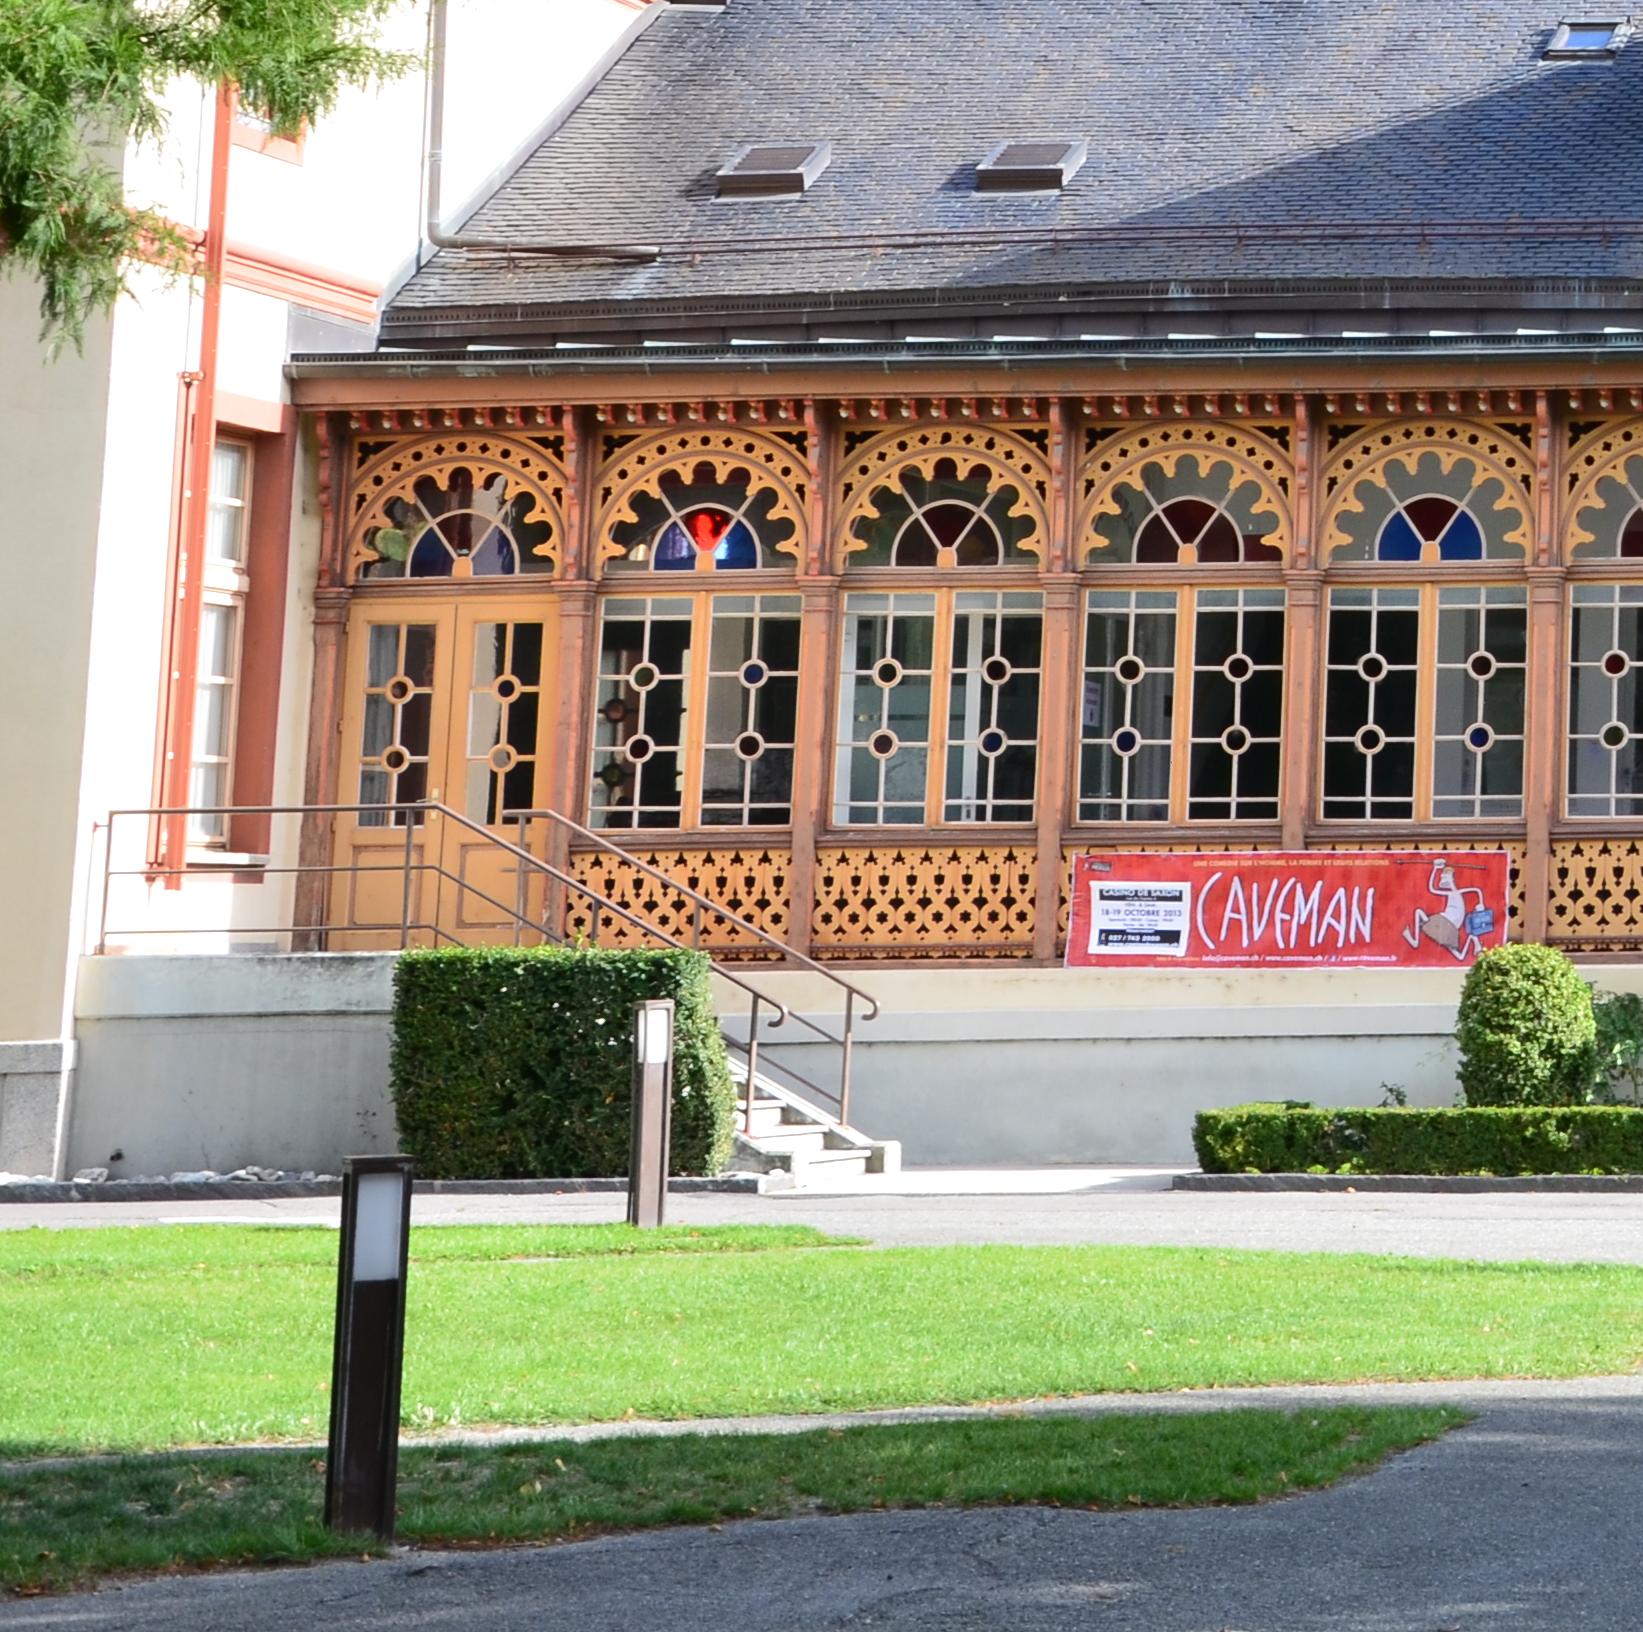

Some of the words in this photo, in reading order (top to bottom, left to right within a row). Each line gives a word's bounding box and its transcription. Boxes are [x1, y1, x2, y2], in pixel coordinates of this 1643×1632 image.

[1124, 909, 1160, 917] OCTOBRE
[1164, 909, 1182, 917] 2013
[1196, 871, 1376, 950] CAVEMAN
